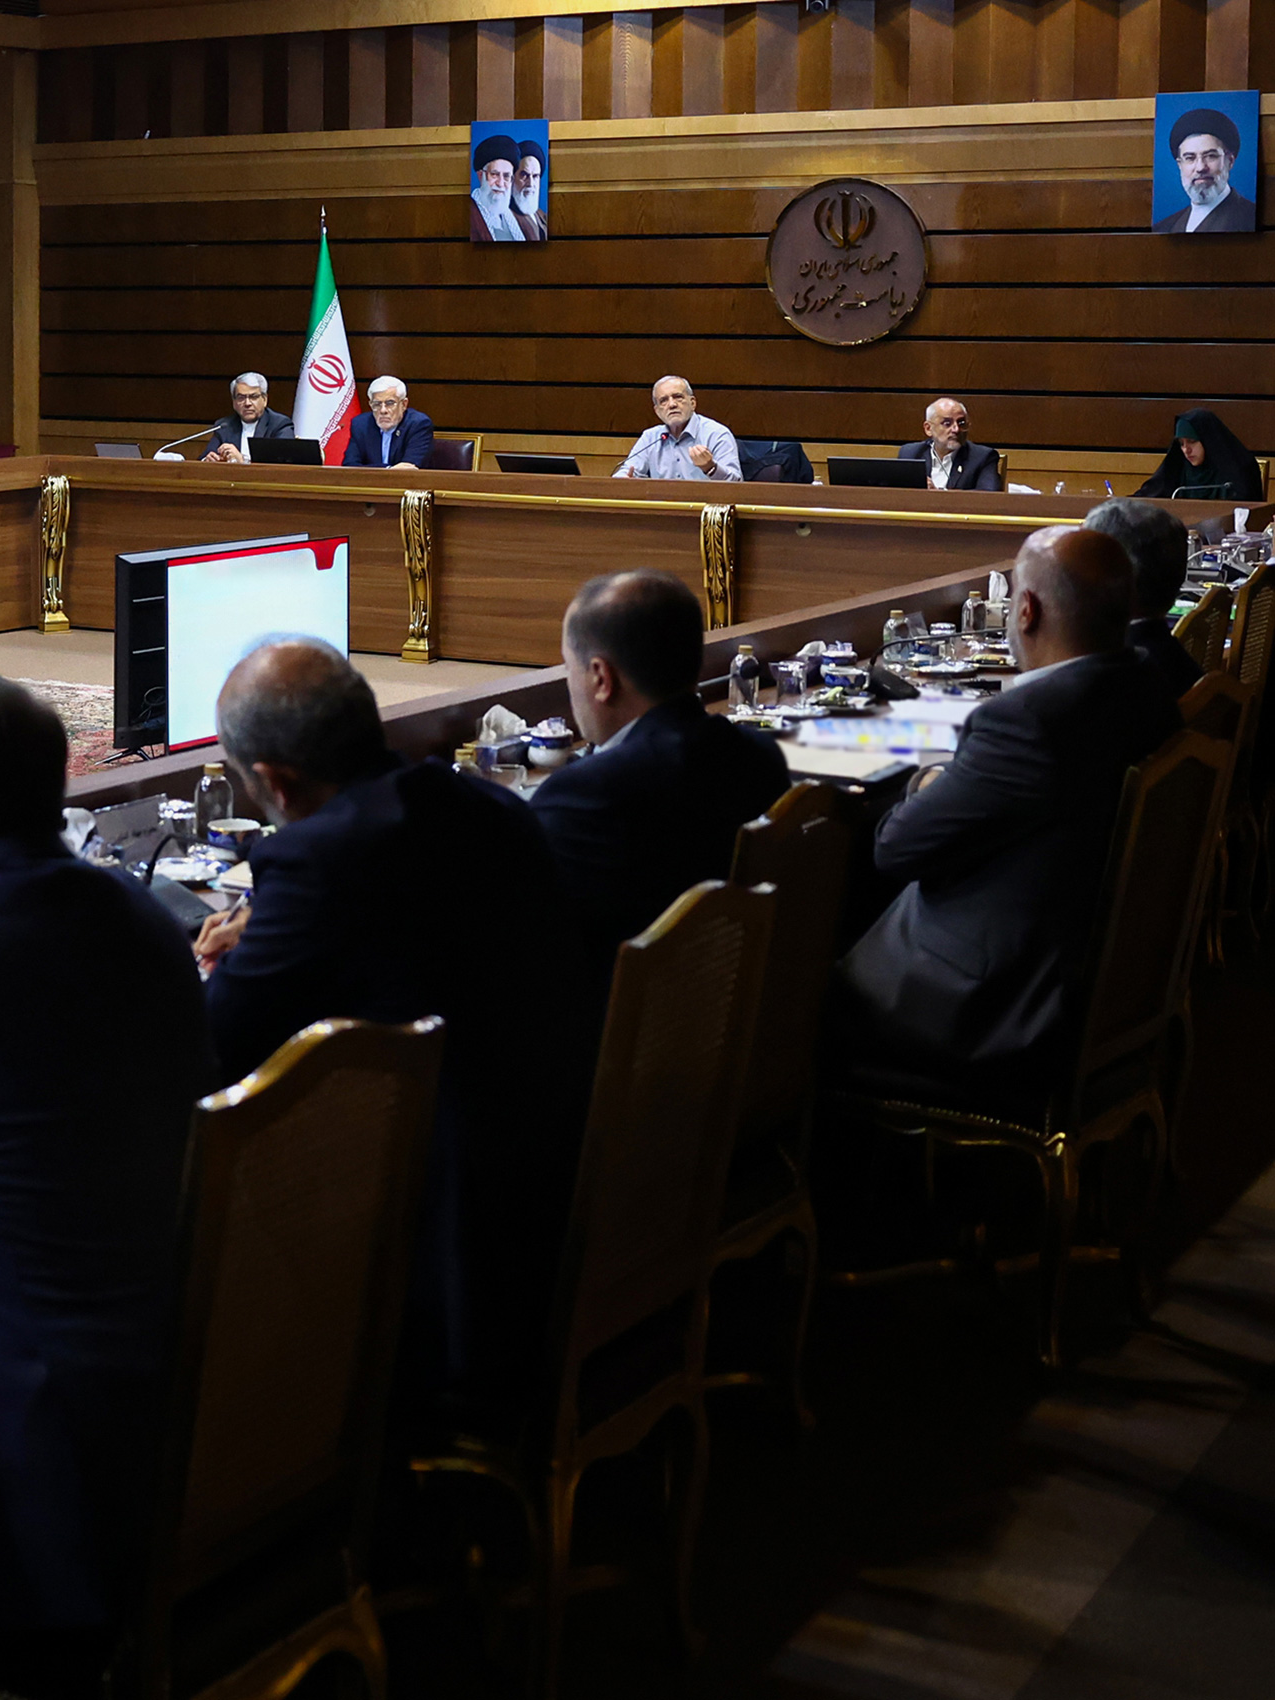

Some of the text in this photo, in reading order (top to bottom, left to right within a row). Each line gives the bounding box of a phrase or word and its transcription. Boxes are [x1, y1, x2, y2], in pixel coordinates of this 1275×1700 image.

[799, 251, 899, 280] جمهوری اسلامی ایران
[791, 284, 906, 319] ریاست جمهوری
